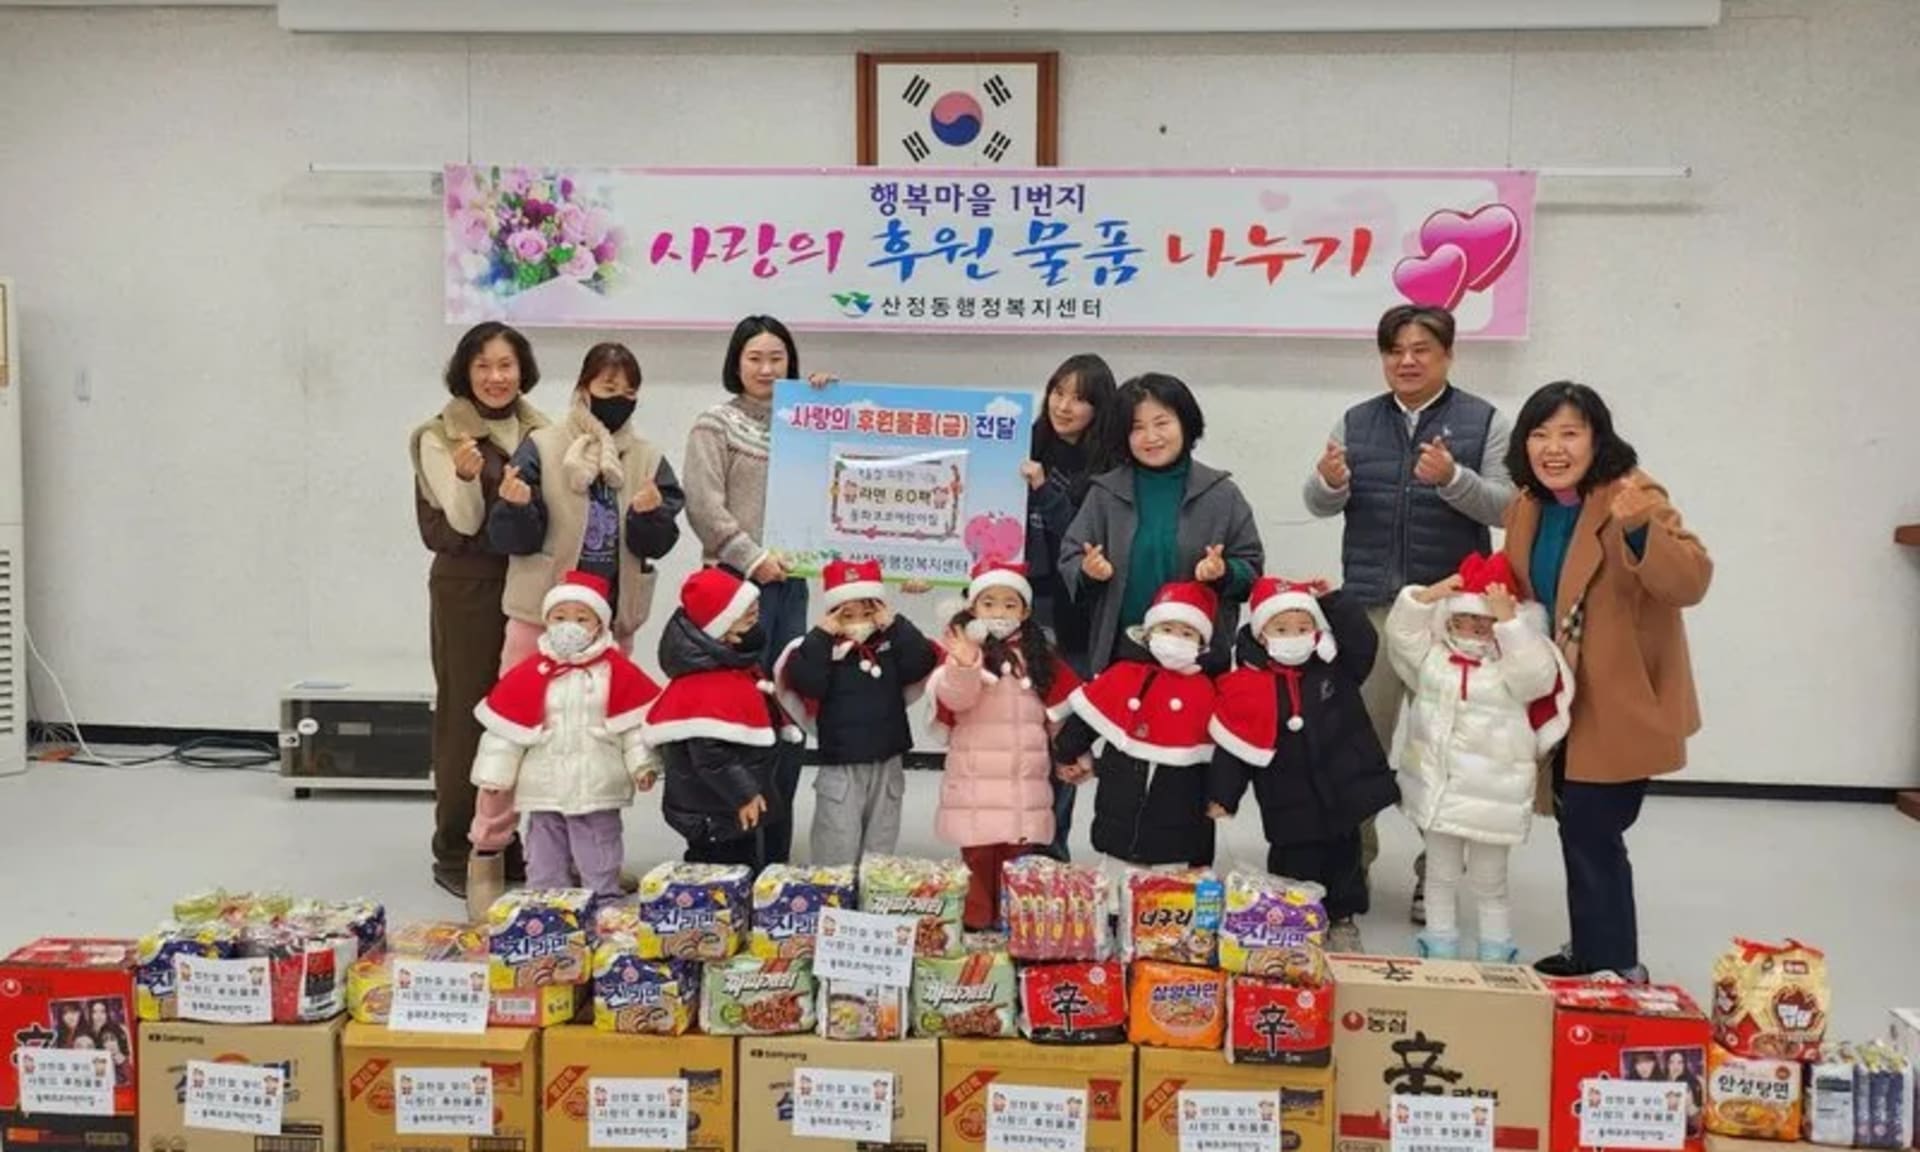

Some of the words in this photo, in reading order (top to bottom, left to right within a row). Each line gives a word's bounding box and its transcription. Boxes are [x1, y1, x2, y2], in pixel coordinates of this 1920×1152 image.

[870, 183, 996, 217] 행복마을
[1010, 184, 1086, 216] 1번지
[650, 222, 845, 280] 사랑의
[866, 218, 1000, 283] 후원
[1012, 219, 1144, 287] 물품
[1166, 224, 1373, 286] 나누기
[881, 297, 1102, 319] 산정동행정복지센터
[790, 405, 850, 430] 사랑의
[855, 408, 969, 438] 후원물품(금)
[974, 413, 1017, 440] 전달
[768, 910, 817, 939] 진라
[1138, 908, 1194, 927] 너구리
[1152, 982, 1219, 1003] 삼양라면
[1367, 1018, 1408, 1034] 농심
[1718, 1074, 1790, 1100] 안성탕면
